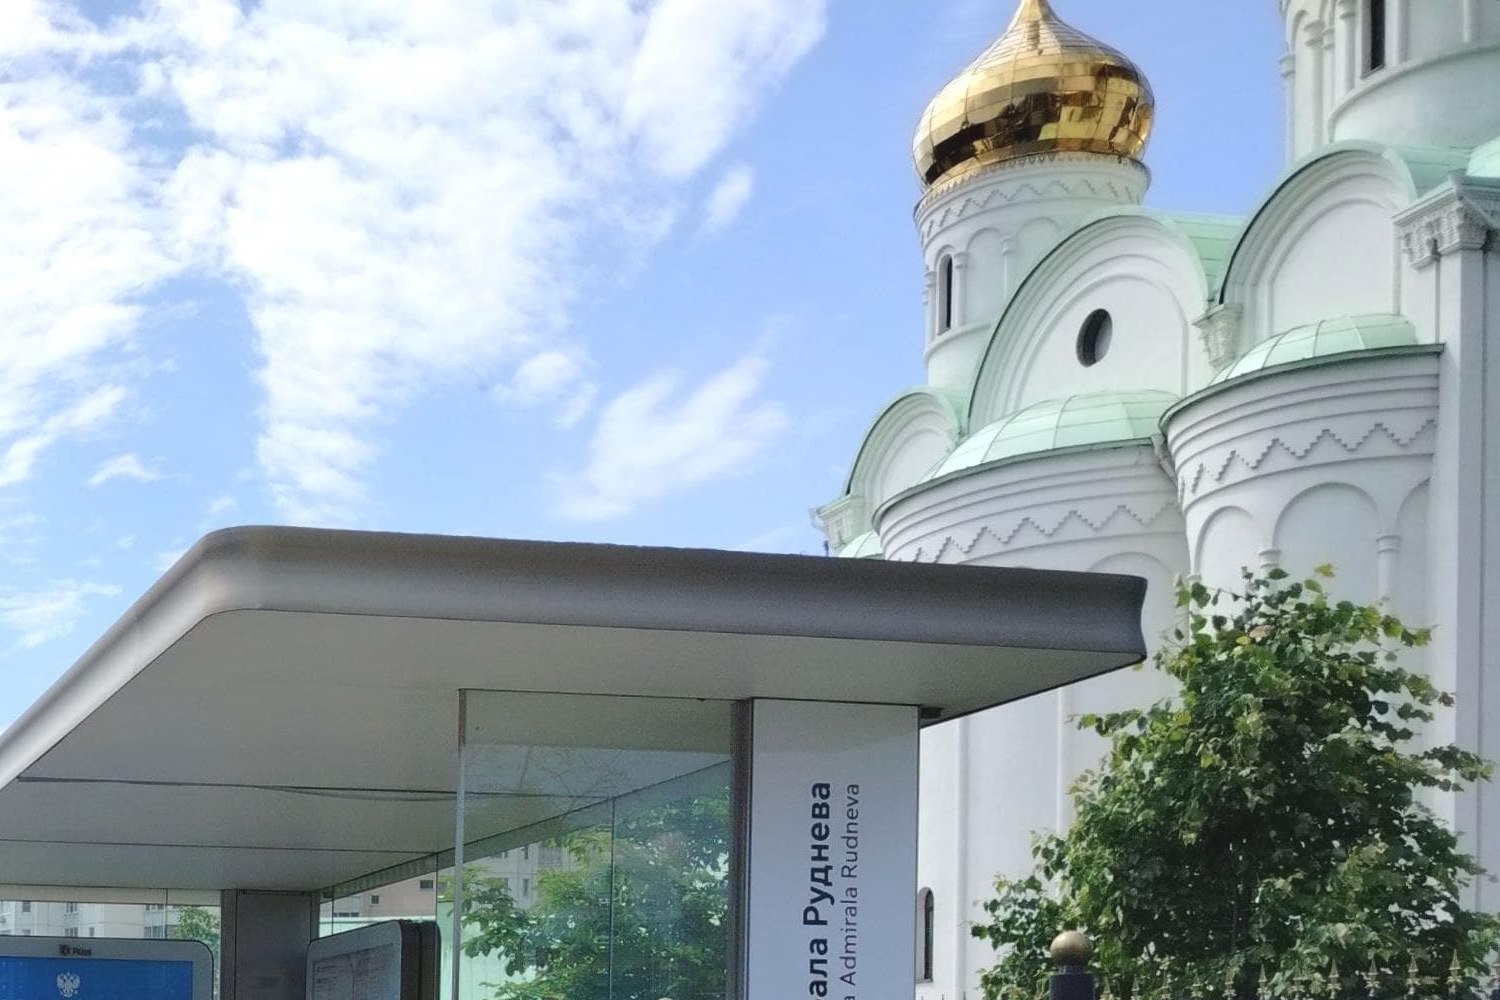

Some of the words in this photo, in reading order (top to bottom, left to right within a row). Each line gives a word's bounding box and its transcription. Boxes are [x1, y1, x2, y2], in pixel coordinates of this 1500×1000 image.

[803, 782, 835, 926] Руднева
[840, 784, 860, 878] Rudneva
[839, 886, 858, 986] Admirala
